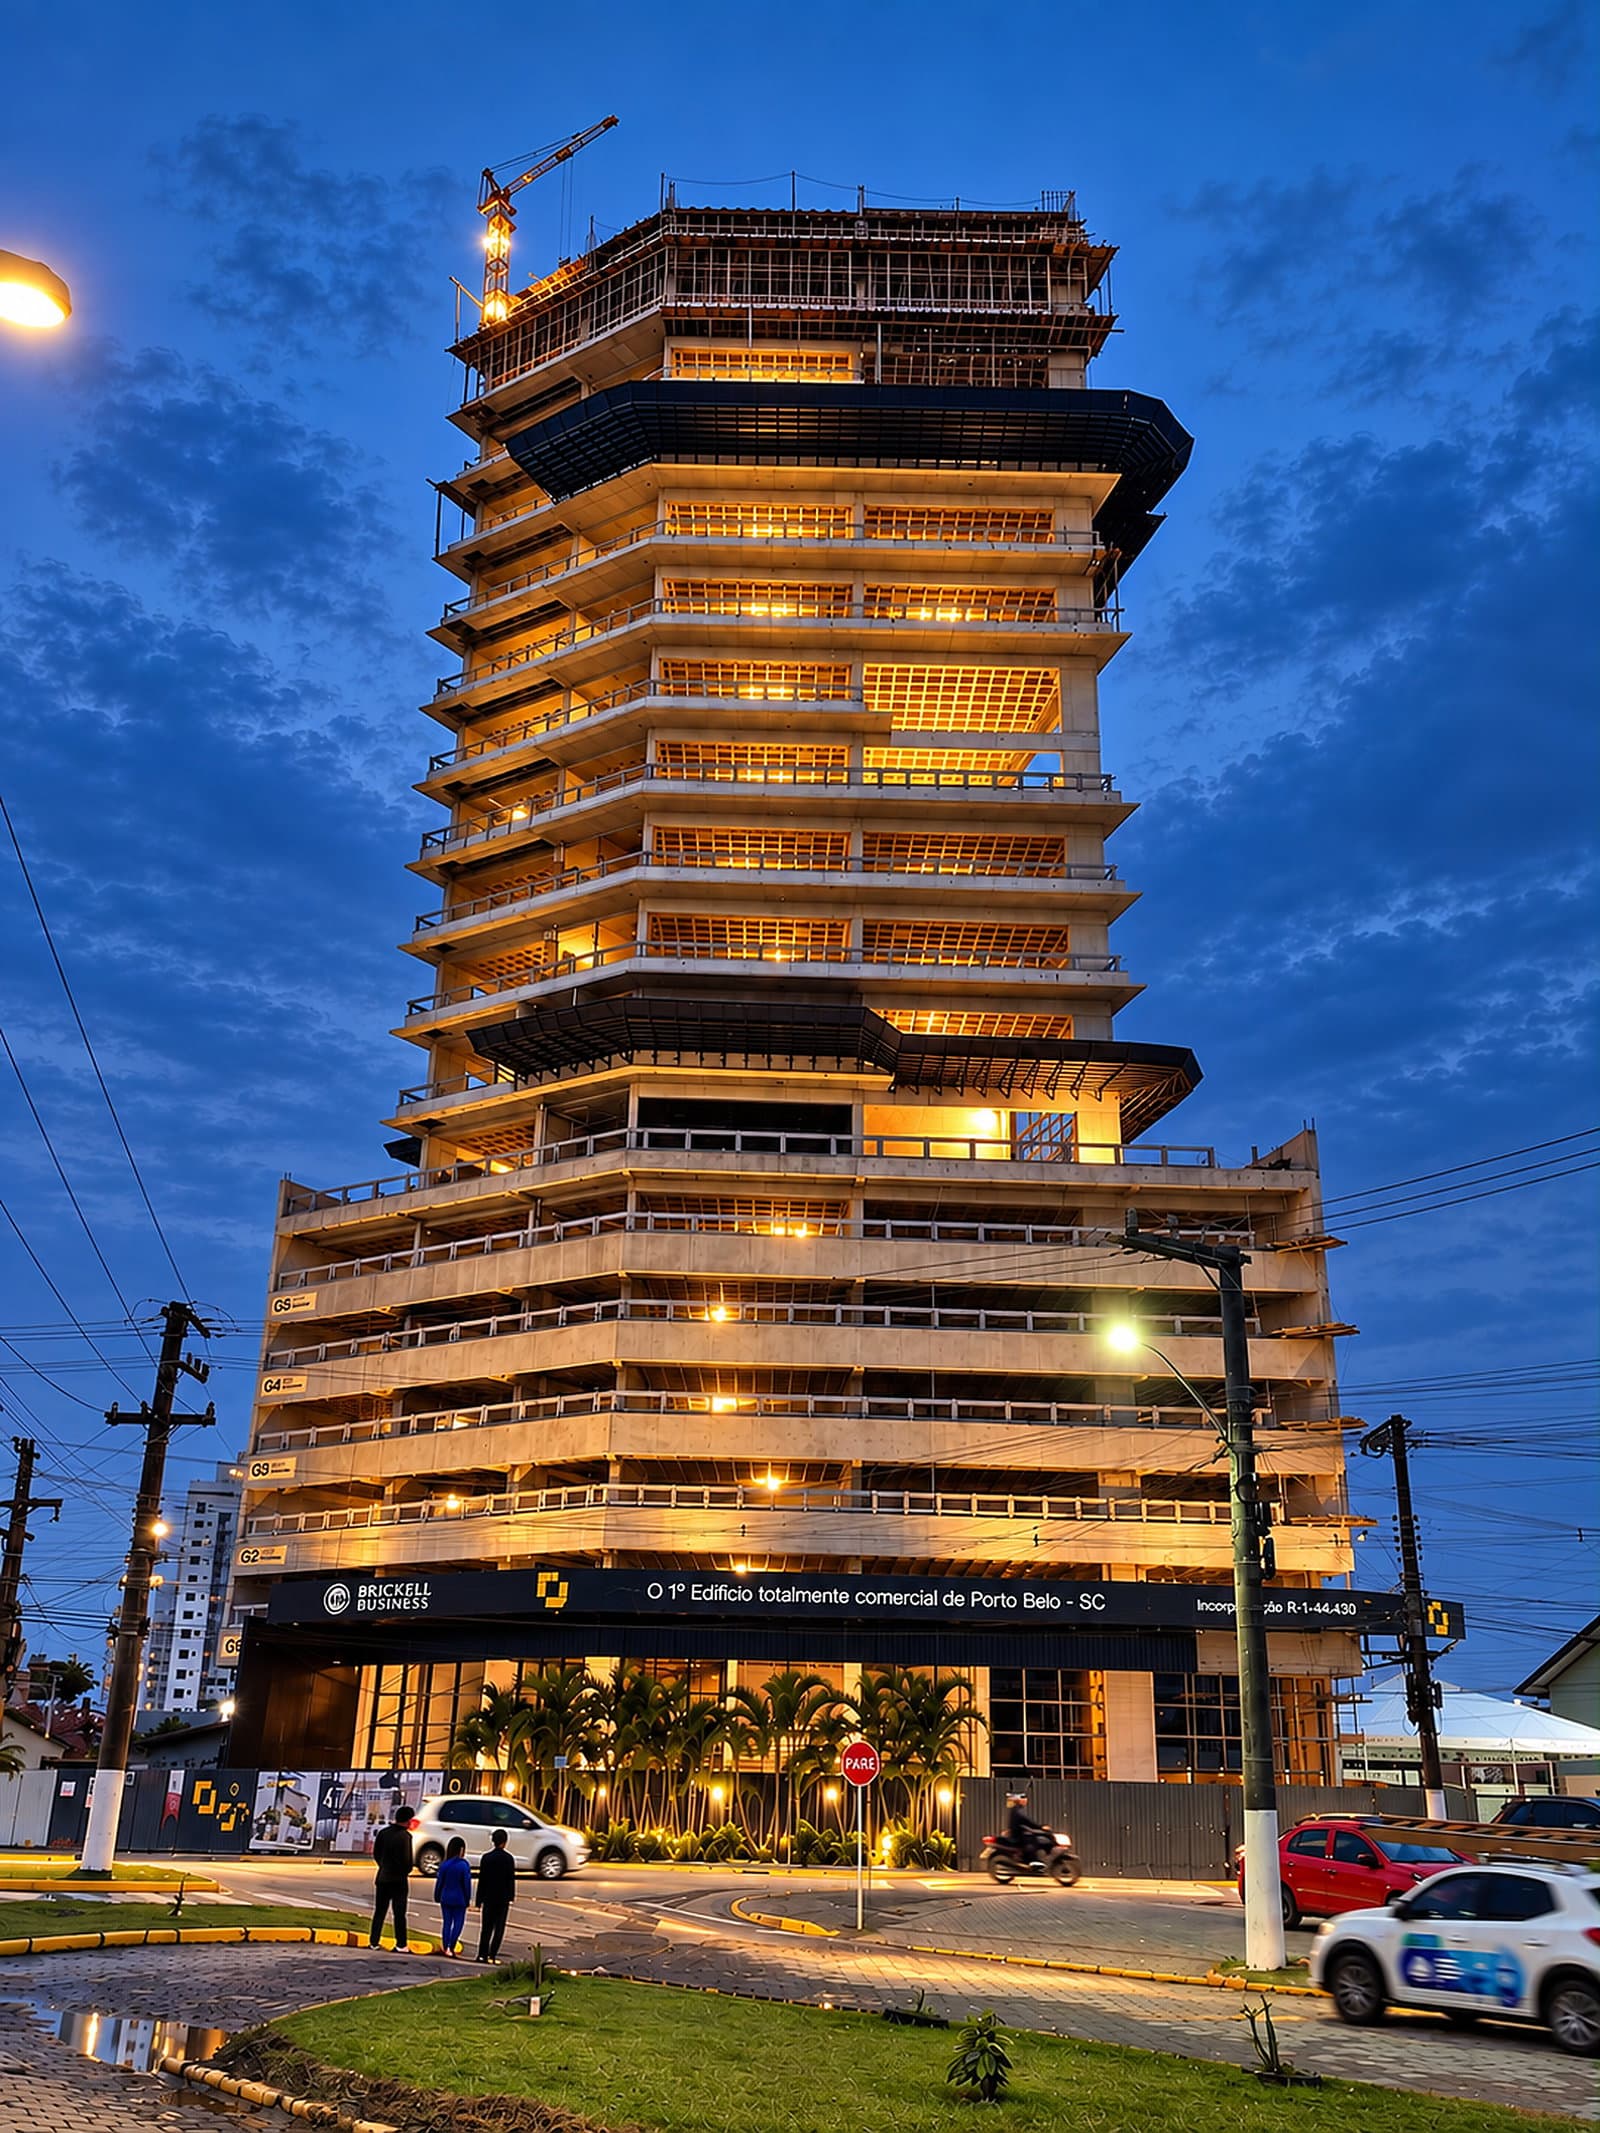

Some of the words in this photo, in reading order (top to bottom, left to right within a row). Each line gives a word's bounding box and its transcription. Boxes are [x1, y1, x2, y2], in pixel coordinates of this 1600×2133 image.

[264, 1379, 281, 1393] G4
[241, 1549, 260, 1564] G2
[358, 1582, 432, 1598] BRICKELL
[647, 1583, 663, 1599] O
[758, 1586, 850, 1604] totalmente
[855, 1589, 938, 1606] comercial
[942, 1590, 966, 1606] de
[971, 1591, 1018, 1608] Porto
[1023, 1593, 1061, 1610] Belo
[1079, 1593, 1106, 1610] SC
[357, 1597, 429, 1611] BUSINESS
[845, 1757, 876, 1770] PARE
